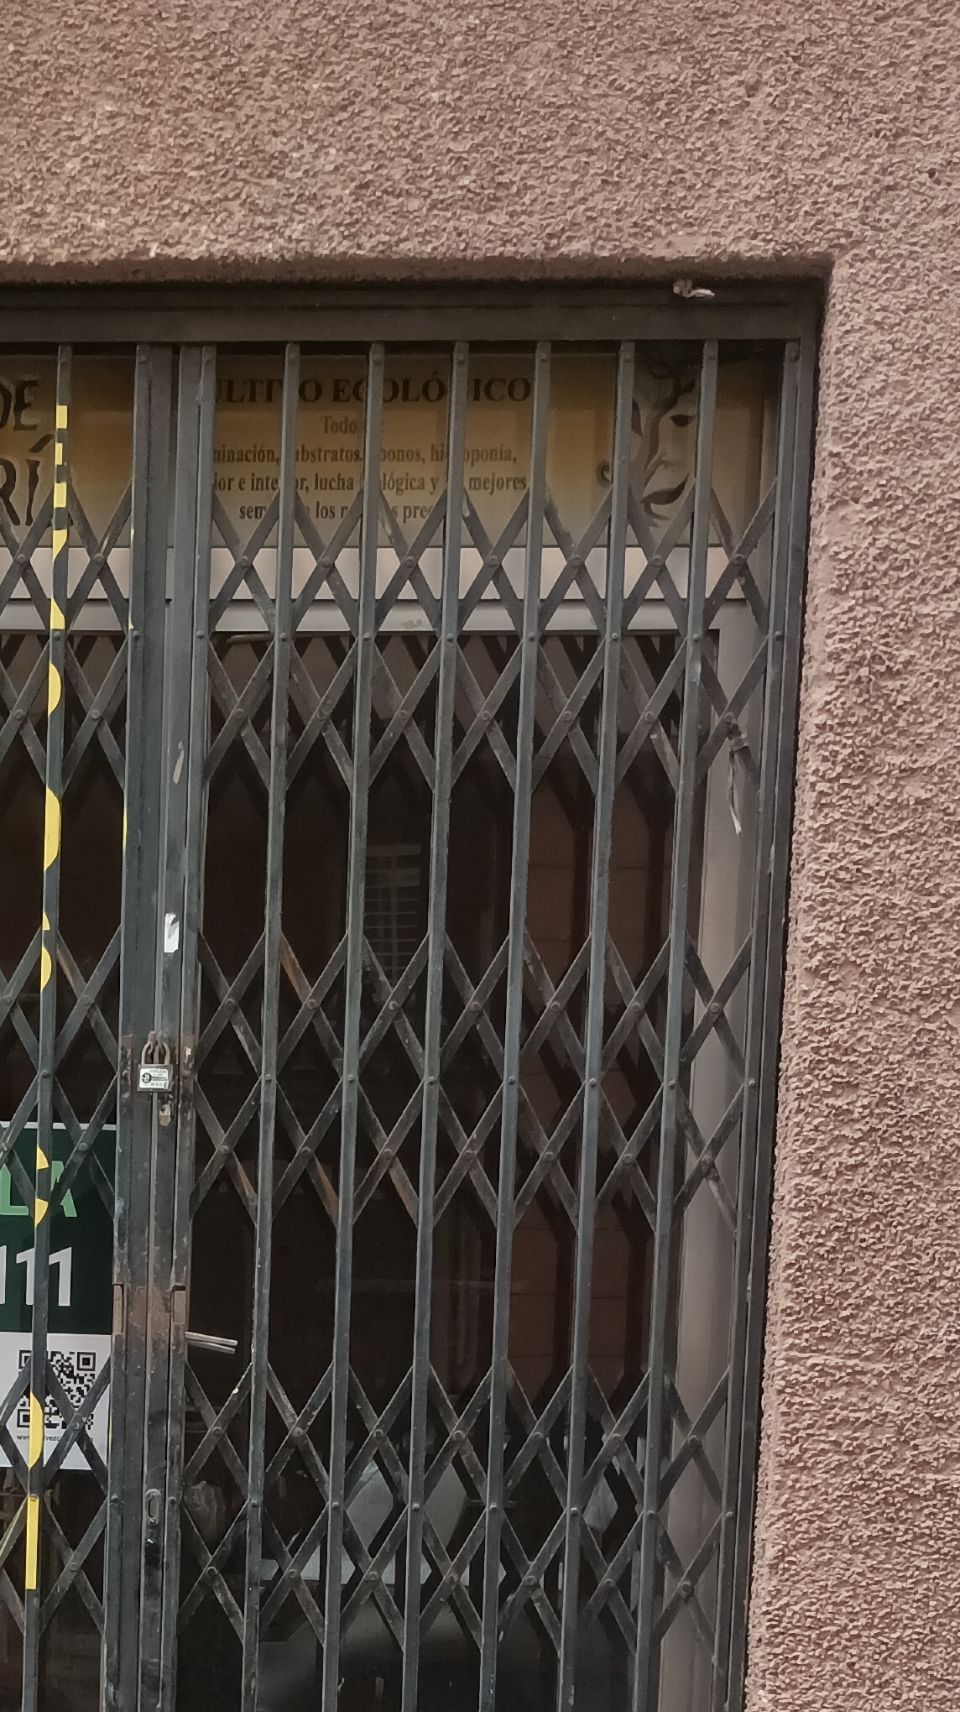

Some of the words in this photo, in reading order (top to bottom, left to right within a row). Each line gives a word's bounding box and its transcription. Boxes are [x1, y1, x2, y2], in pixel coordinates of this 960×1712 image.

[332, 372, 532, 403] ECOLÓICO
[321, 415, 358, 434] Todo
[376, 443, 426, 464] bonos,
[430, 443, 518, 468] hioponía,
[250, 472, 310, 492] inteor,
[314, 472, 354, 491] lucha
[360, 471, 426, 496] lógica
[468, 473, 528, 495] mejores
[315, 501, 337, 520] los
